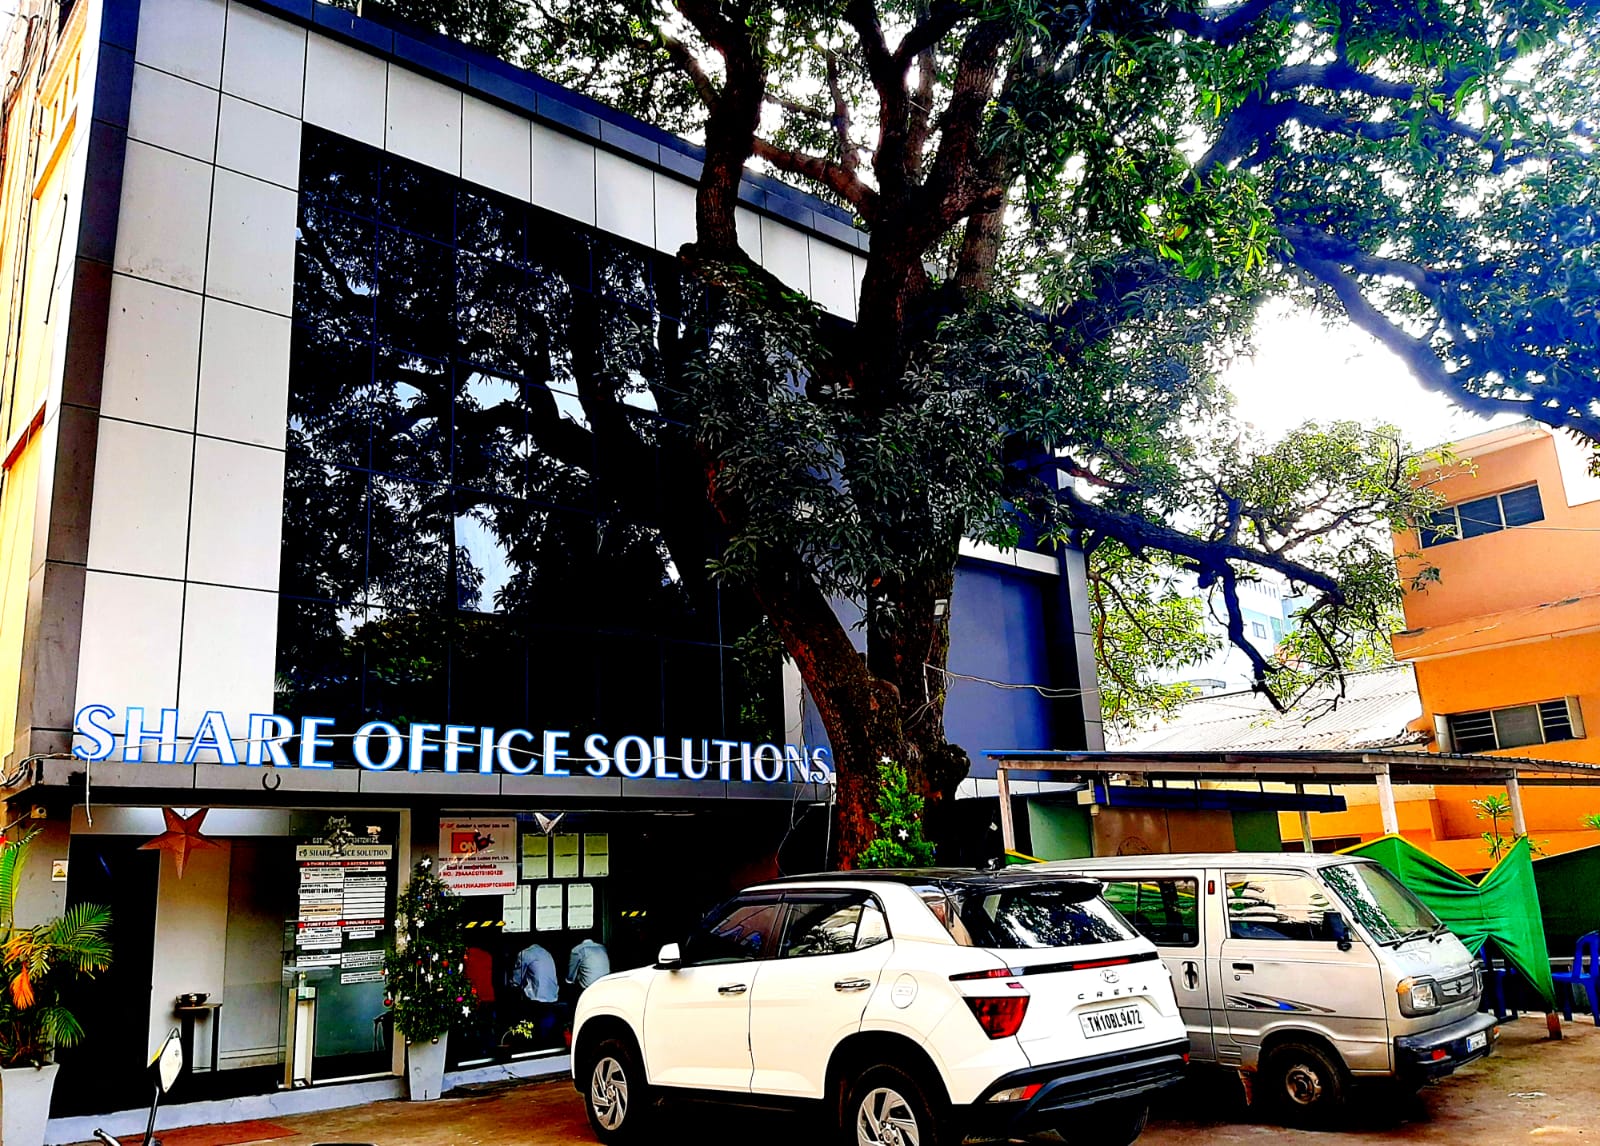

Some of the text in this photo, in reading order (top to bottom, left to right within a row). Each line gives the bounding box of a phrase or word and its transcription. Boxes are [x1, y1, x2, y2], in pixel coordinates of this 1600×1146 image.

[71, 704, 831, 785] SHARE OFFICE SOLUTIONS
[1077, 985, 1148, 1000] CRETA
[1087, 1009, 1143, 1032] TN10BL9472
